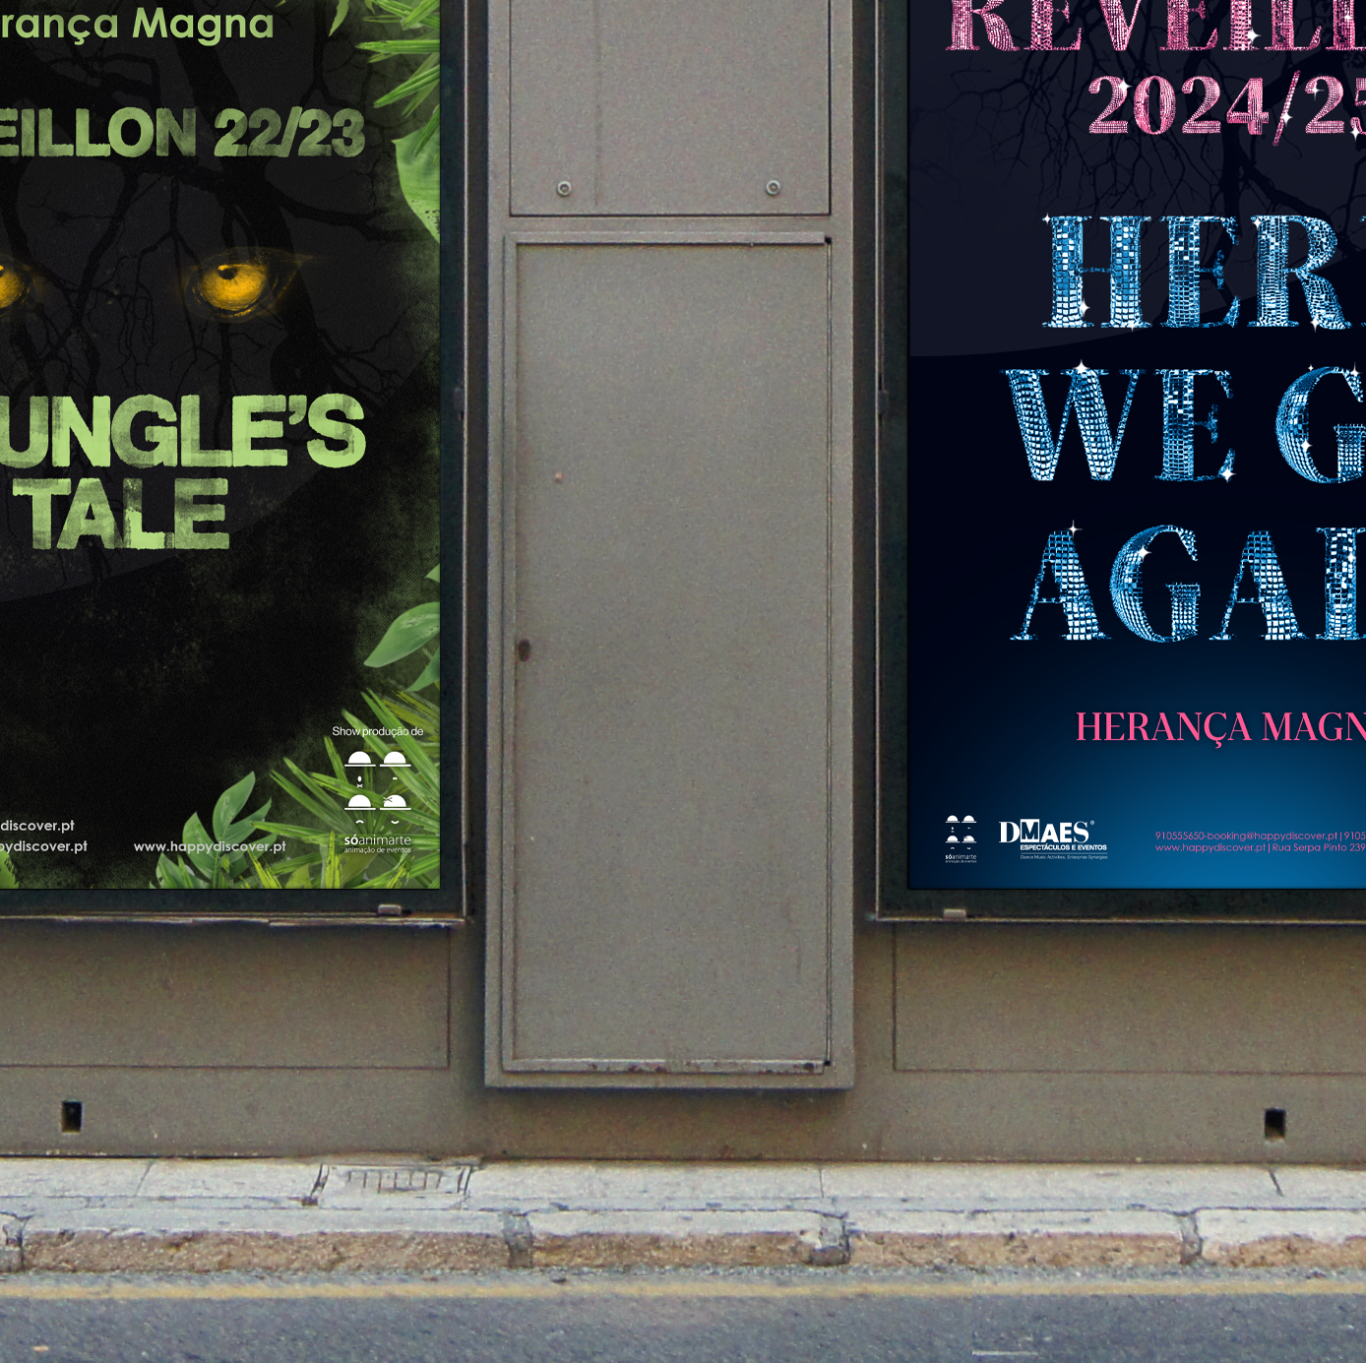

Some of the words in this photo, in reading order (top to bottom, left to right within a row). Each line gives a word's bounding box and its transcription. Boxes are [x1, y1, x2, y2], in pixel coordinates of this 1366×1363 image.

[132, 7, 274, 46] Magna
[213, 105, 366, 158] 22/23
[1000, 366, 1235, 482] WE
[11, 477, 230, 550] TALE
[332, 726, 361, 736] Show
[362, 726, 410, 738] produção
[411, 726, 424, 736] de
[1076, 711, 1253, 749] HERANÇA
[344, 834, 412, 845] sóanimarte
[134, 840, 287, 854] www.happydiscover.pt
[344, 846, 376, 854] animação
[1020, 843, 1070, 851] ESPECTÁCULOS
[1293, 843, 1321, 854] Serpa
[1323, 843, 1348, 852] Pinto
